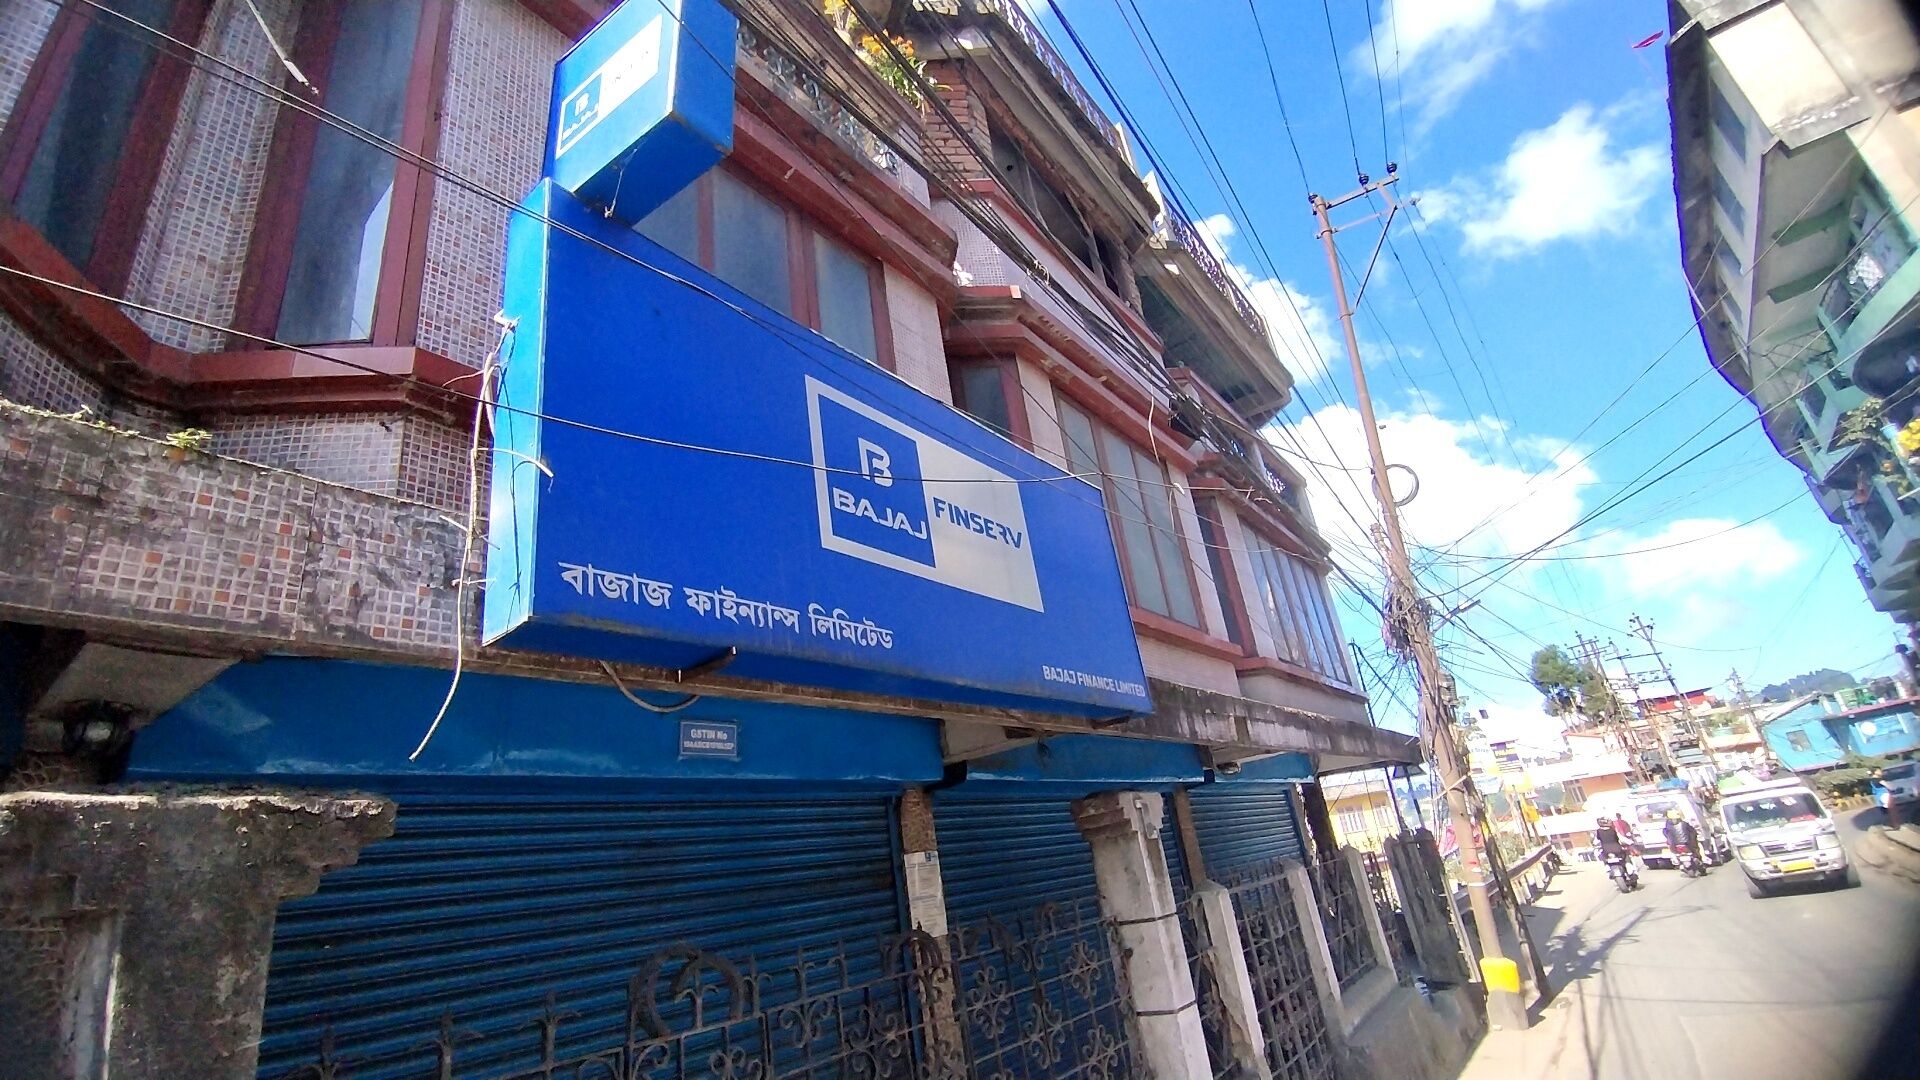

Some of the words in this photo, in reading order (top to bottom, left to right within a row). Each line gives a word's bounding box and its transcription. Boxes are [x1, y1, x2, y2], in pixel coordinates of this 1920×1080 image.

[832, 487, 928, 540] BAJAJ
[932, 496, 1022, 549] FINSERV
[558, 561, 674, 610] বাজাজ
[683, 585, 801, 634] ফাইন্যান্স
[807, 602, 894, 650] লিমিটেড
[1042, 665, 1077, 685] BAJAJ
[1077, 671, 1117, 692] FINANCE
[1115, 680, 1146, 697] LIMITED
